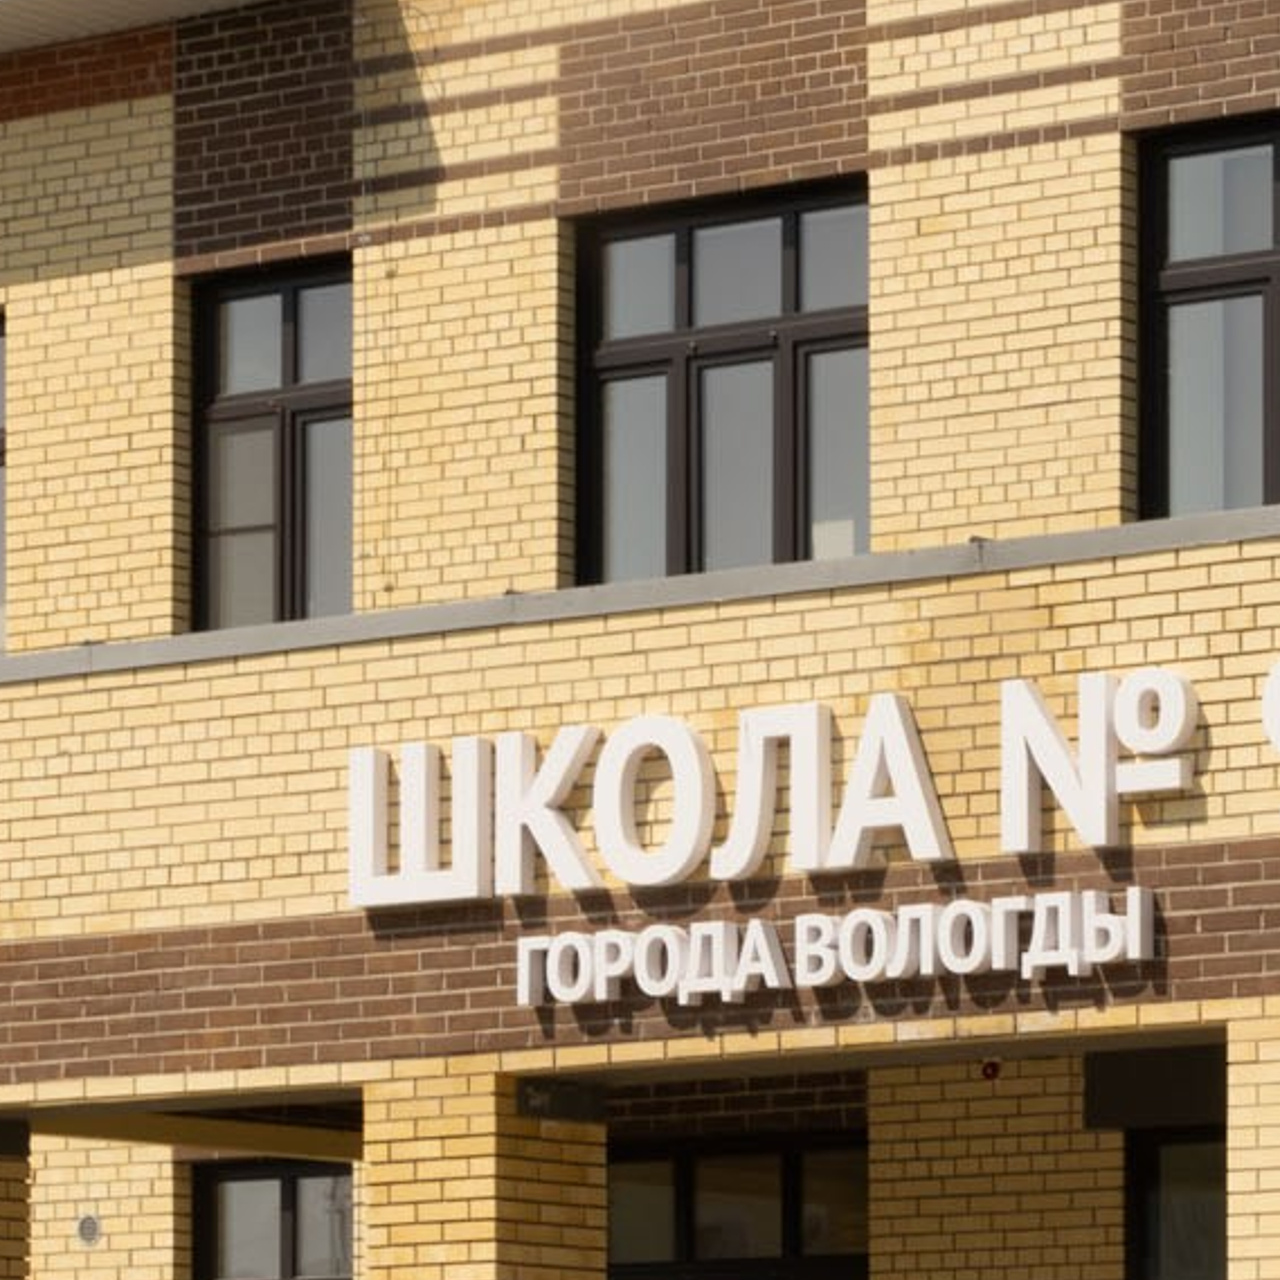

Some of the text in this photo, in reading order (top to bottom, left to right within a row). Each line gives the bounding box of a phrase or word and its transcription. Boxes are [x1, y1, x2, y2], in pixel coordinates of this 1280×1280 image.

[347, 693, 953, 908] ШКОЛА
[1000, 667, 1197, 854] №
[517, 887, 1155, 1006] ГОРОДА ВОЛОГДЫ
